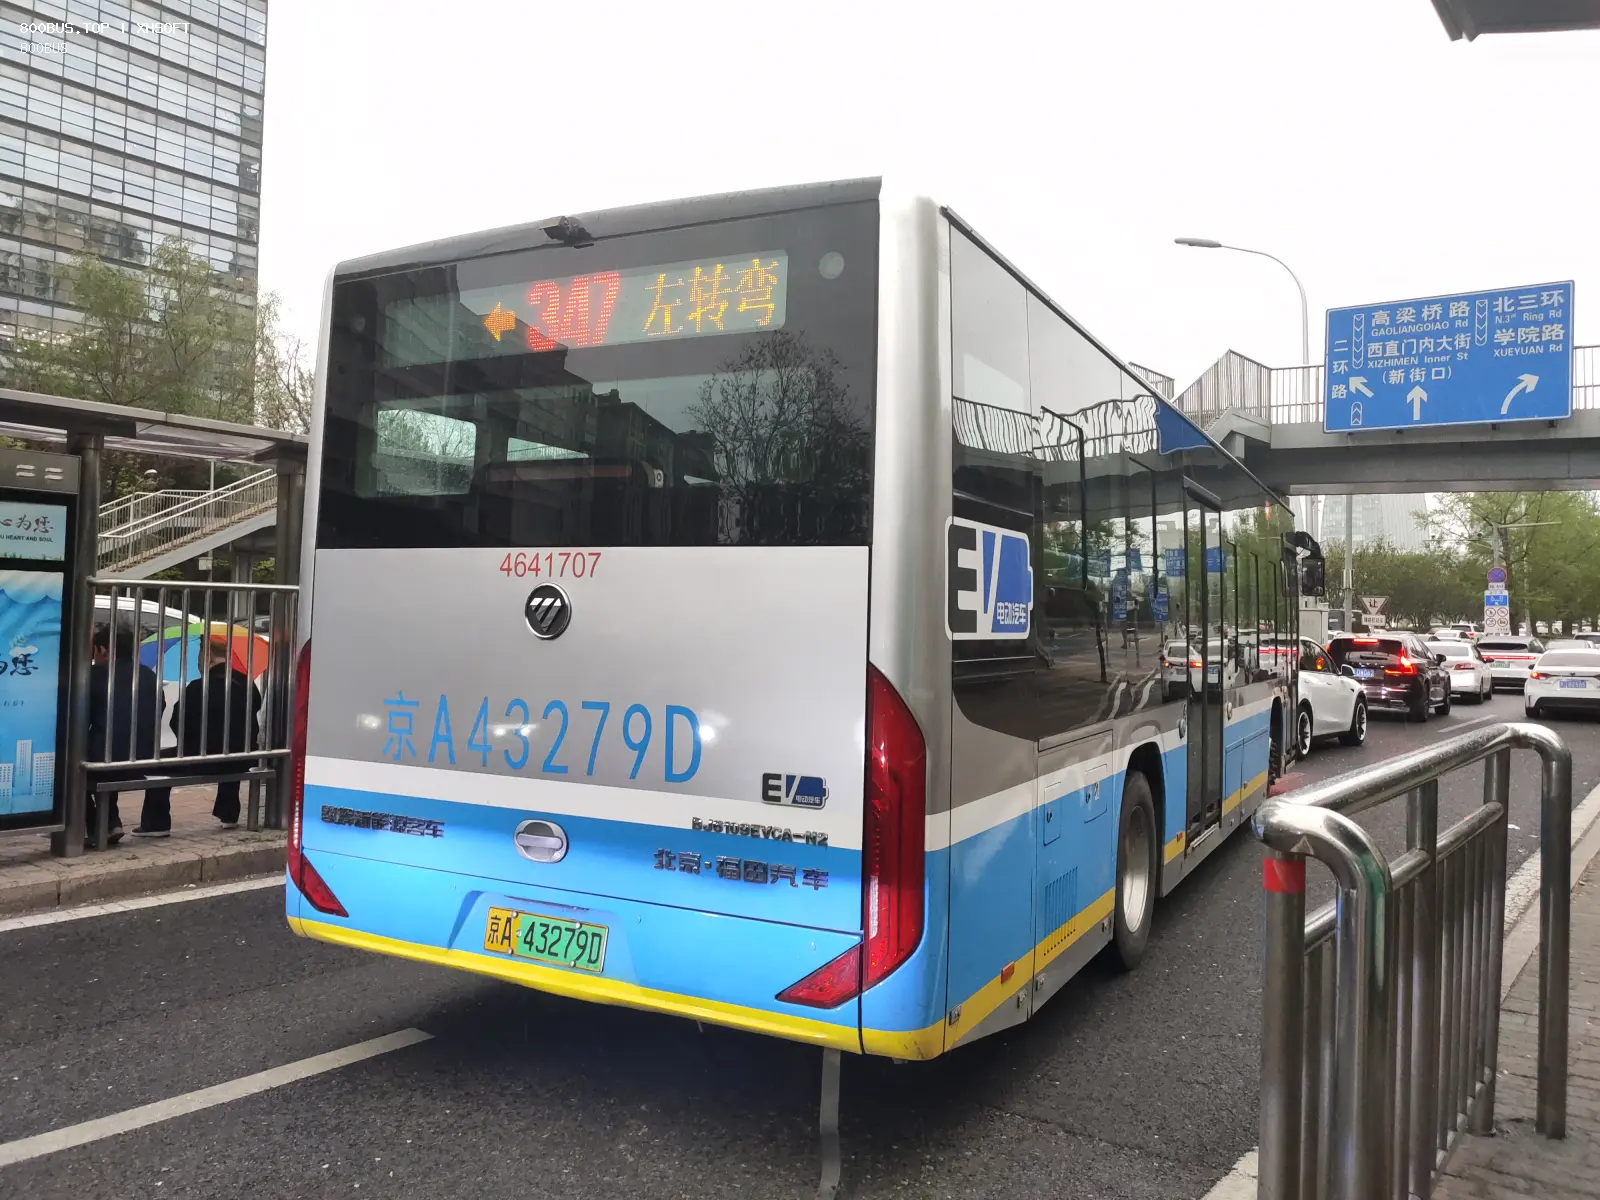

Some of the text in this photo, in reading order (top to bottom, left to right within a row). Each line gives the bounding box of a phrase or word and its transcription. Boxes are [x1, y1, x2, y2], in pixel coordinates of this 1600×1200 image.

[528, 258, 780, 351] 347 左转弯
[1492, 290, 1565, 313] 北三环
[1455, 319, 1469, 329] Rd
[1522, 312, 1544, 322] Ring
[1549, 309, 1562, 319] Rd
[1367, 333, 1472, 358] 西直门内大街
[1493, 323, 1565, 346] 学院路
[1367, 351, 1469, 369] XIZHIMEN Inner St
[1492, 343, 1563, 358] XUEYUAN Rd
[1331, 339, 1349, 400] 二环路
[499, 551, 602, 578] 4641707
[996, 601, 1027, 625] 电动汽车
[1368, 598, 1379, 609] 让
[383, 690, 702, 783] 京A43279D
